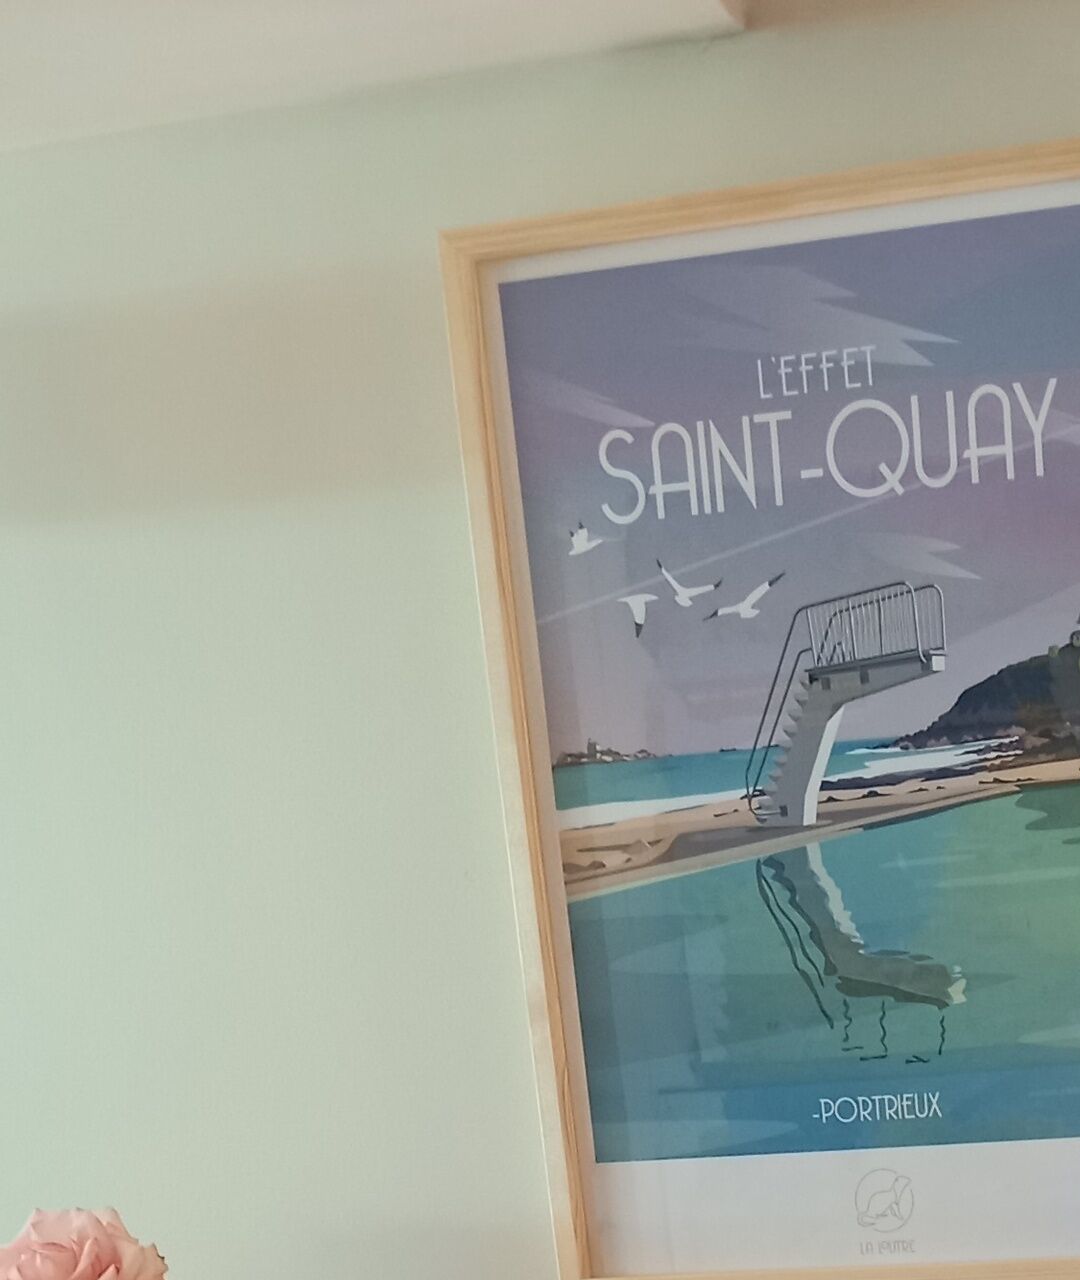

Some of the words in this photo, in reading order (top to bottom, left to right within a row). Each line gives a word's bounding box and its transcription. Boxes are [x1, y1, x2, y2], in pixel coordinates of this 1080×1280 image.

[757, 344, 877, 399] L'EFFET
[597, 377, 1059, 526] SAINT-QUAY
[811, 1091, 943, 1124] -PORTRIEUX
